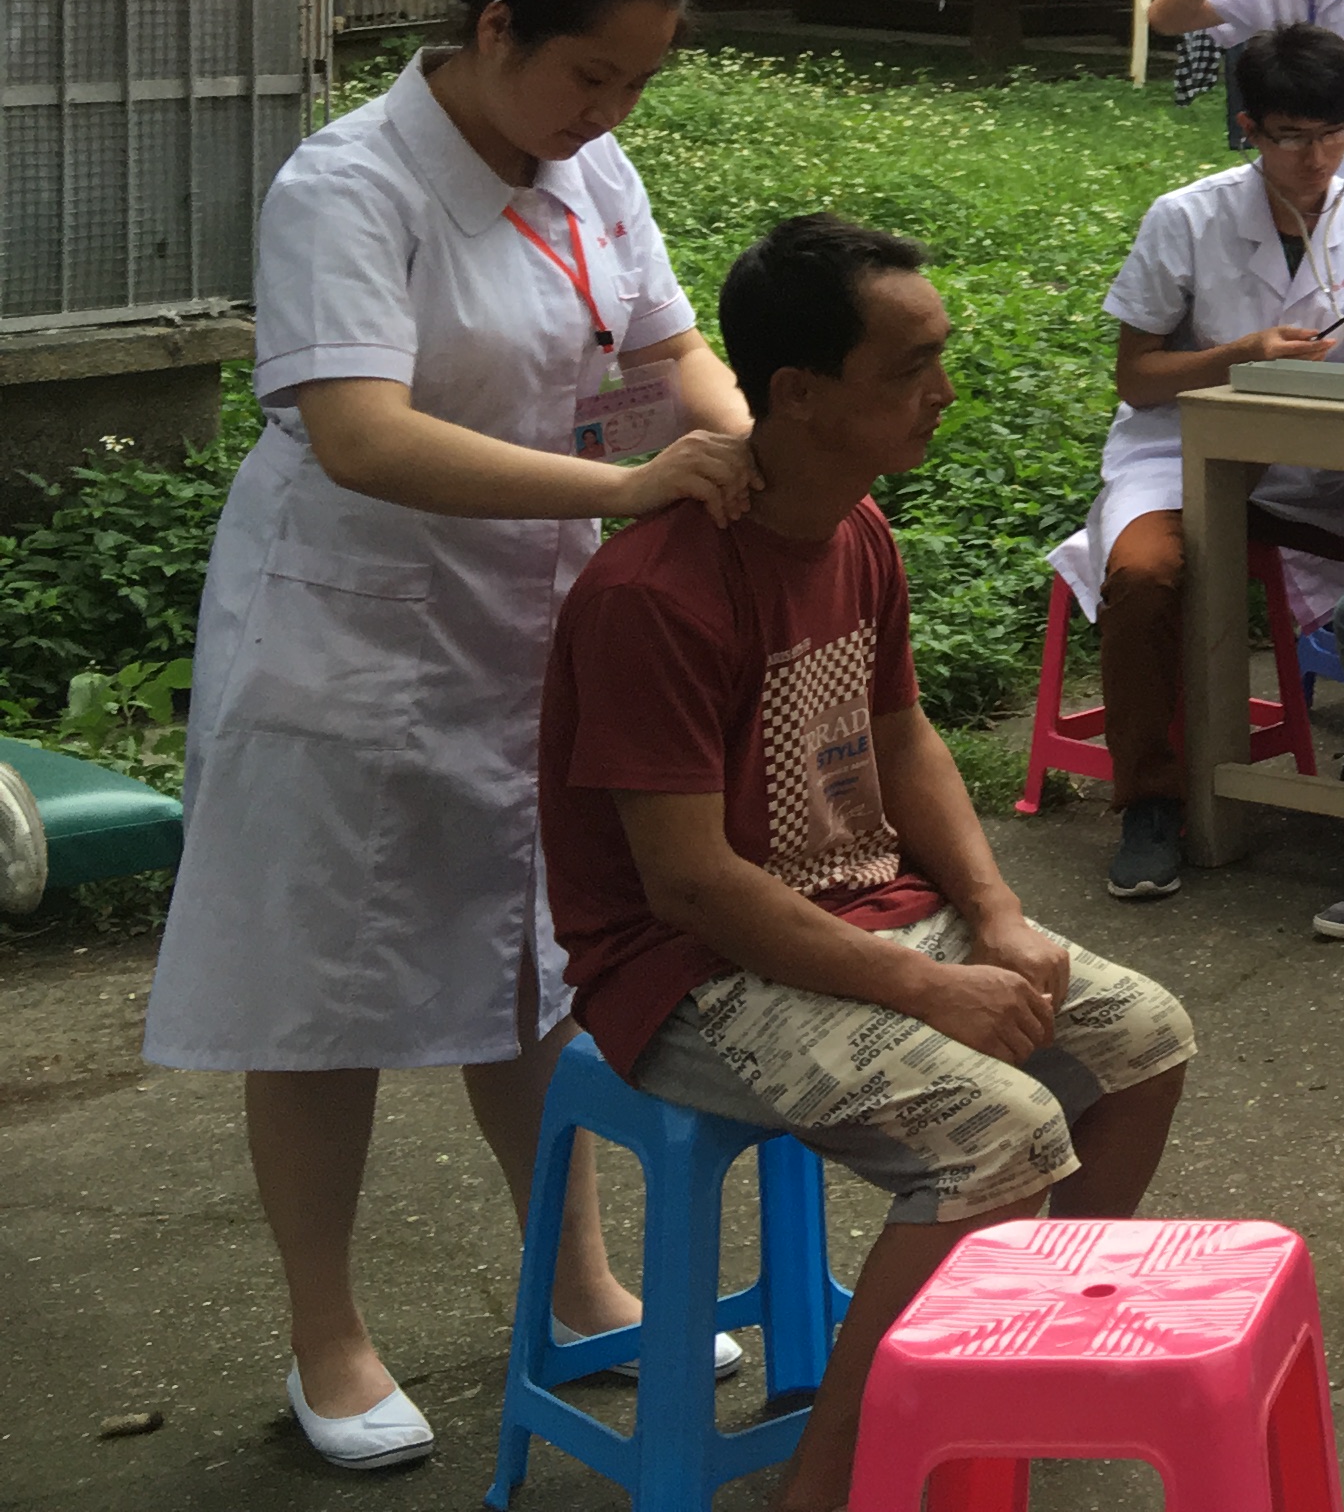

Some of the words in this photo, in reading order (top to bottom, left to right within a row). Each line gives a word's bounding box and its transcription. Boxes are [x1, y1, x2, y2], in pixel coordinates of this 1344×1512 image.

[815, 735, 869, 771] STYLE
[847, 1010, 897, 1048] TANGO
[931, 1088, 983, 1125] TANGO
